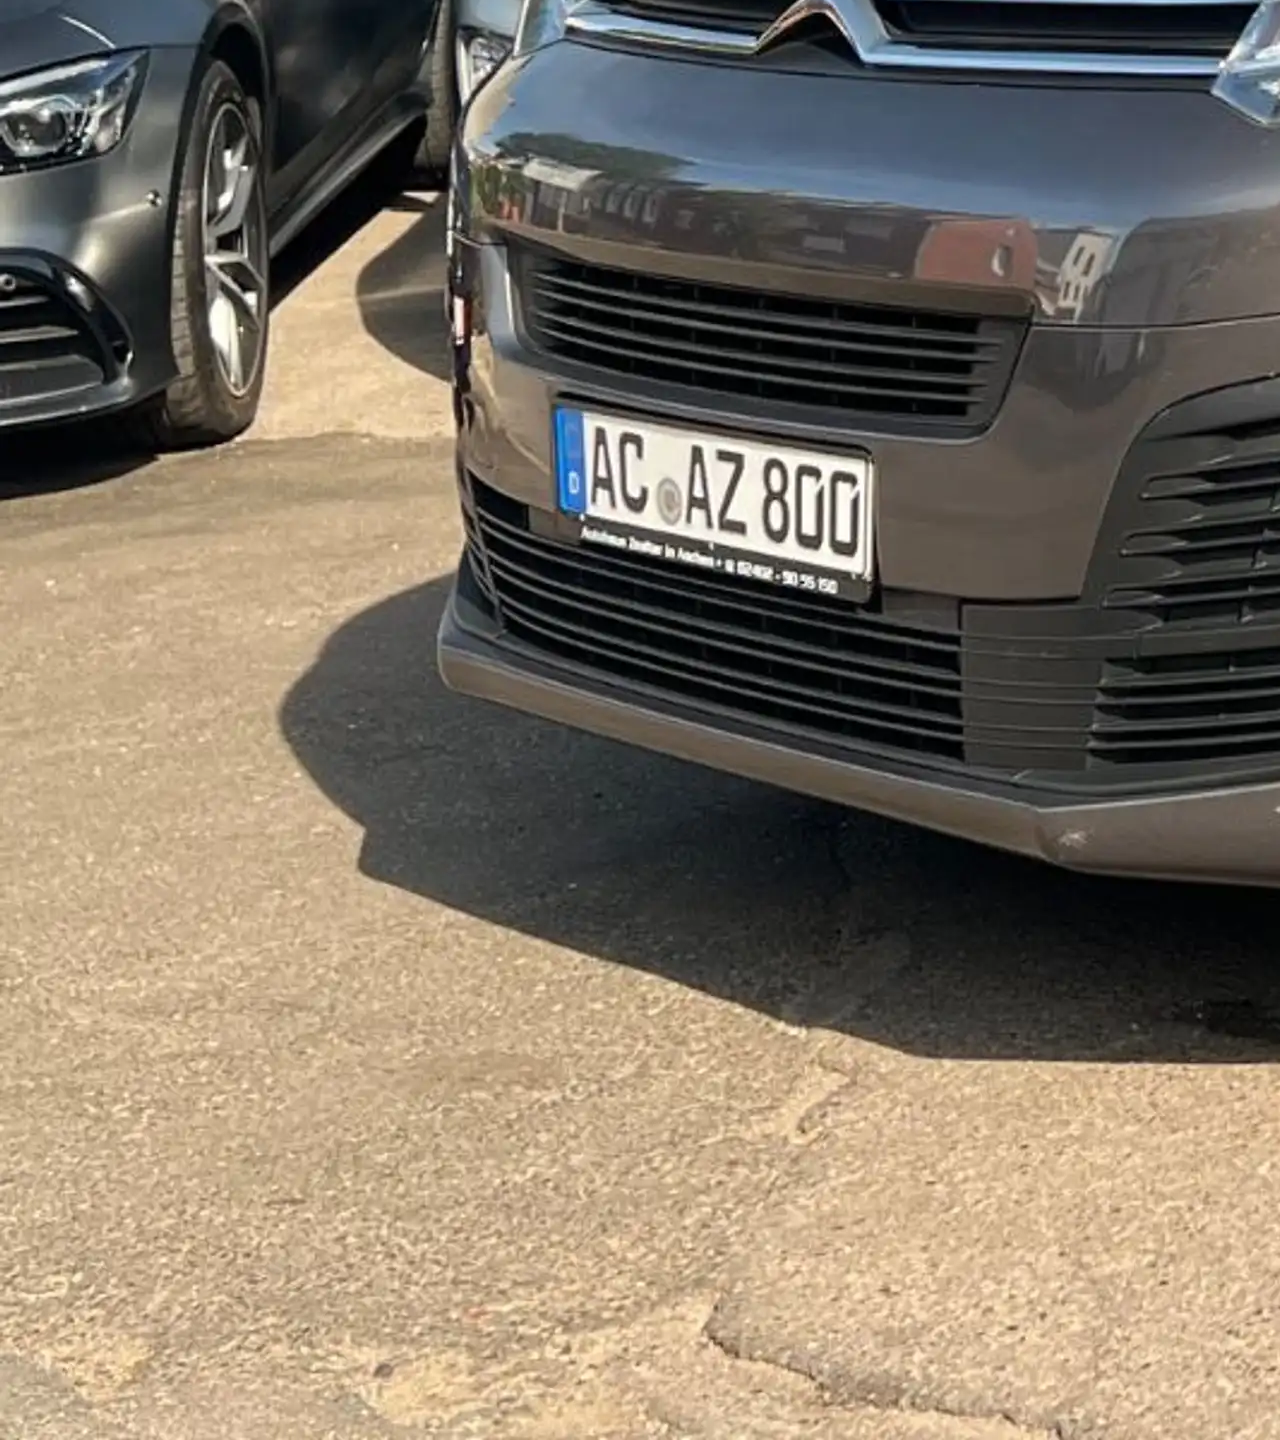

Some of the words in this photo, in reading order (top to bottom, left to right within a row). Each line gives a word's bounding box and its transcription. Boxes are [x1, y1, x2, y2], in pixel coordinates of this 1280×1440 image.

[591, 426, 649, 514] AC
[686, 445, 748, 535] AZ
[762, 458, 860, 558] 800
